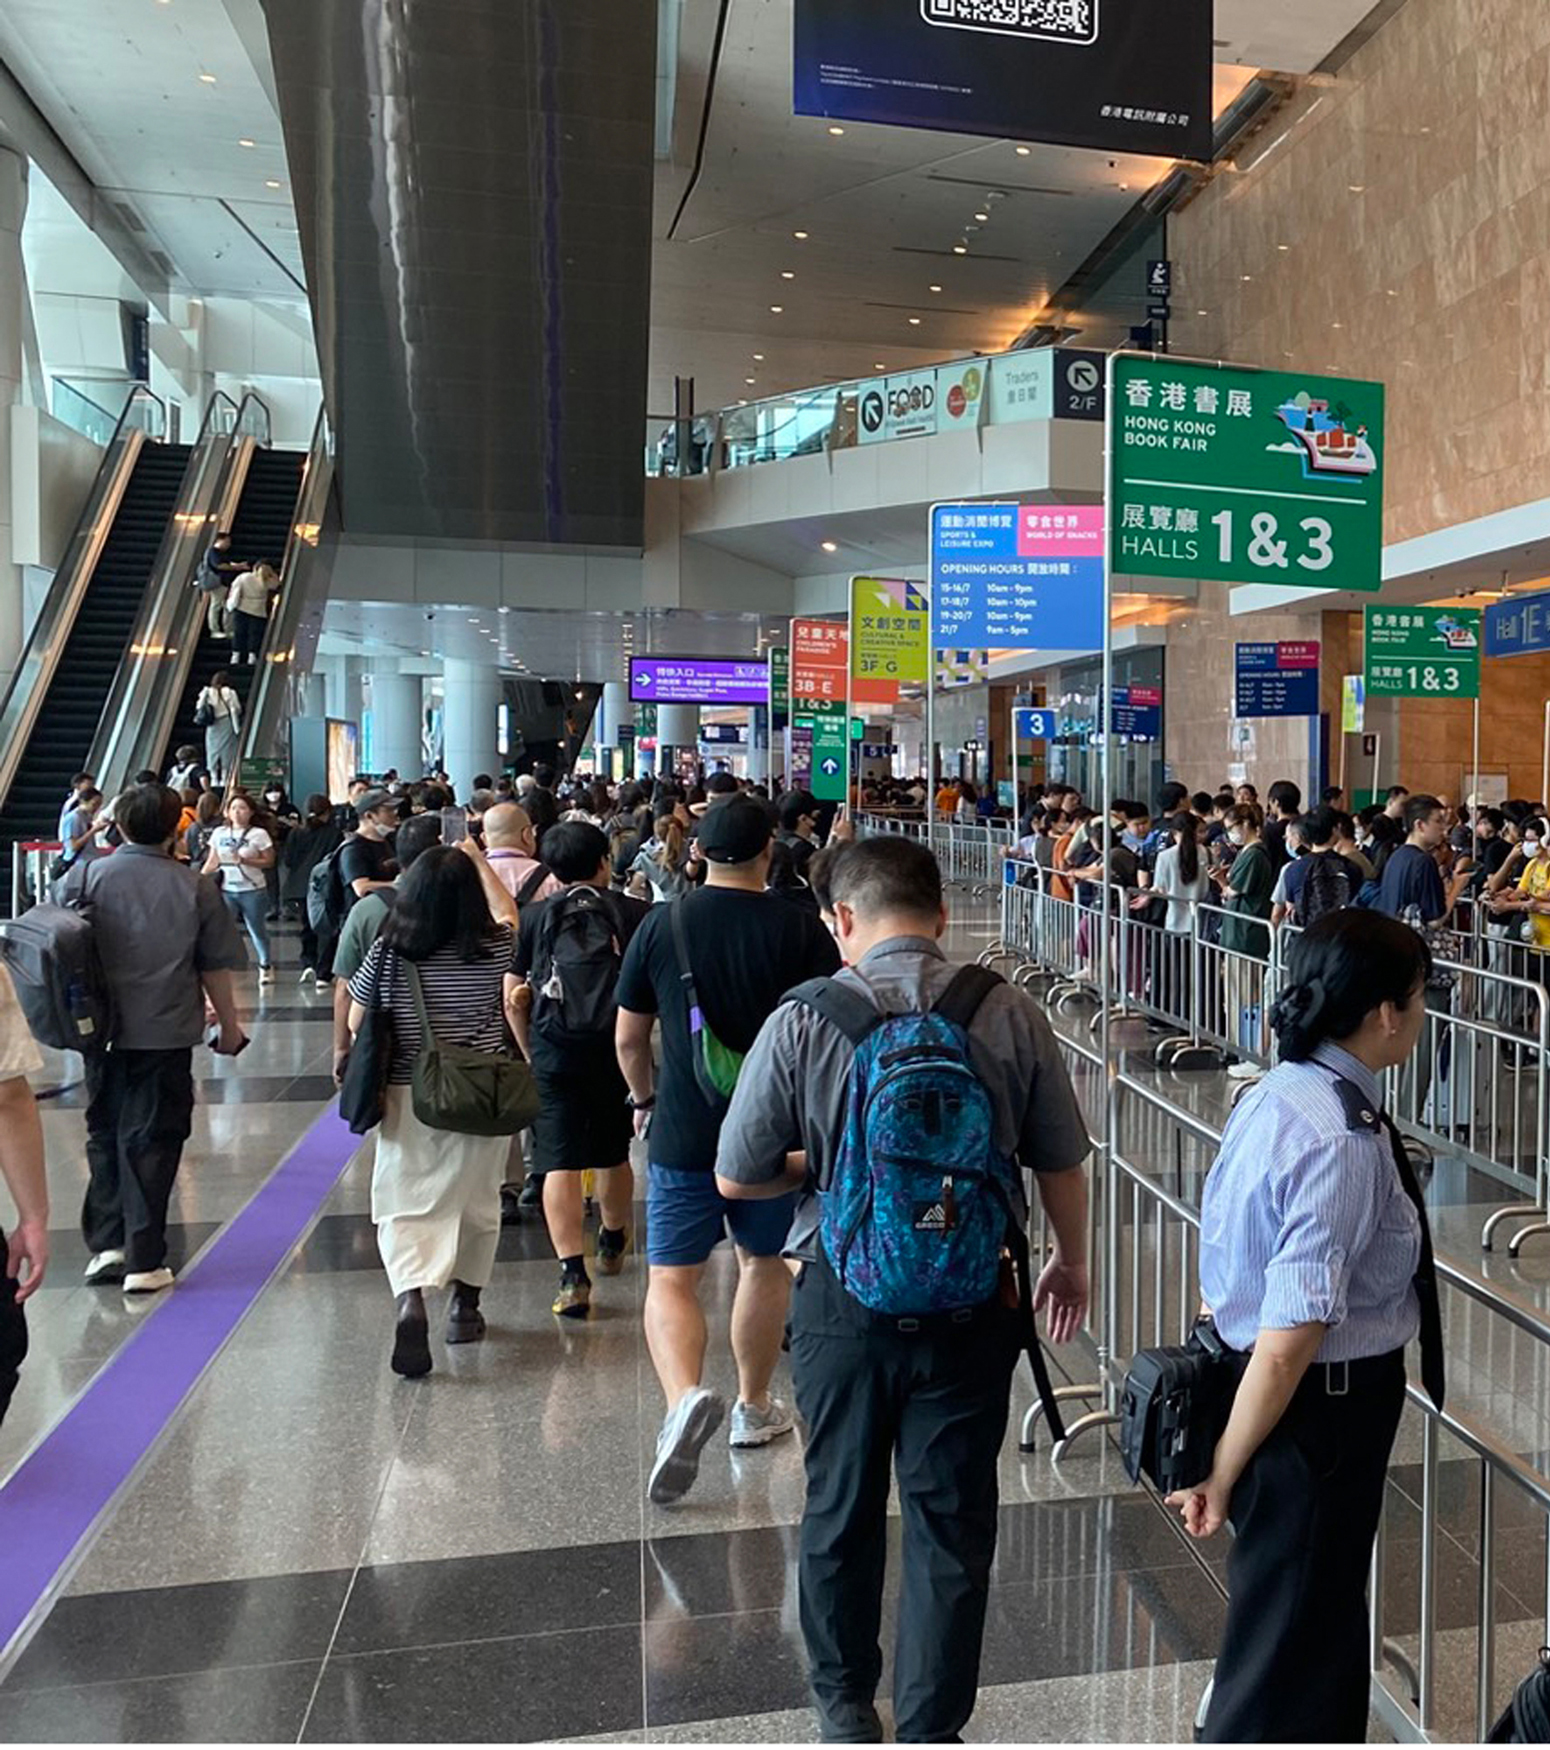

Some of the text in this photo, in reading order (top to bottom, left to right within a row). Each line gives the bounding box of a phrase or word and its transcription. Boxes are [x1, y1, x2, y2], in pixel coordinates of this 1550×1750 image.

[1069, 395, 1097, 410] 2/F
[1125, 378, 1253, 418] 香港書展
[1124, 415, 1217, 437] HONG KONG
[1124, 431, 1208, 452] BOOK FAIR
[1026, 514, 1078, 528] 零食世界
[1121, 503, 1199, 534] 展覽廳
[940, 540, 994, 548] LEISURE EXPO
[1121, 535, 1198, 561] HALLS
[1211, 510, 1334, 571] 1&3
[940, 563, 1025, 575] OPENING HOURS
[861, 616, 921, 632] 文創空間
[1371, 613, 1425, 629] 香港書展
[1496, 604, 1542, 645] Hall 1E
[1371, 680, 1403, 690] HALLS
[1406, 666, 1460, 691] 1&3
[1030, 714, 1045, 734] 3
